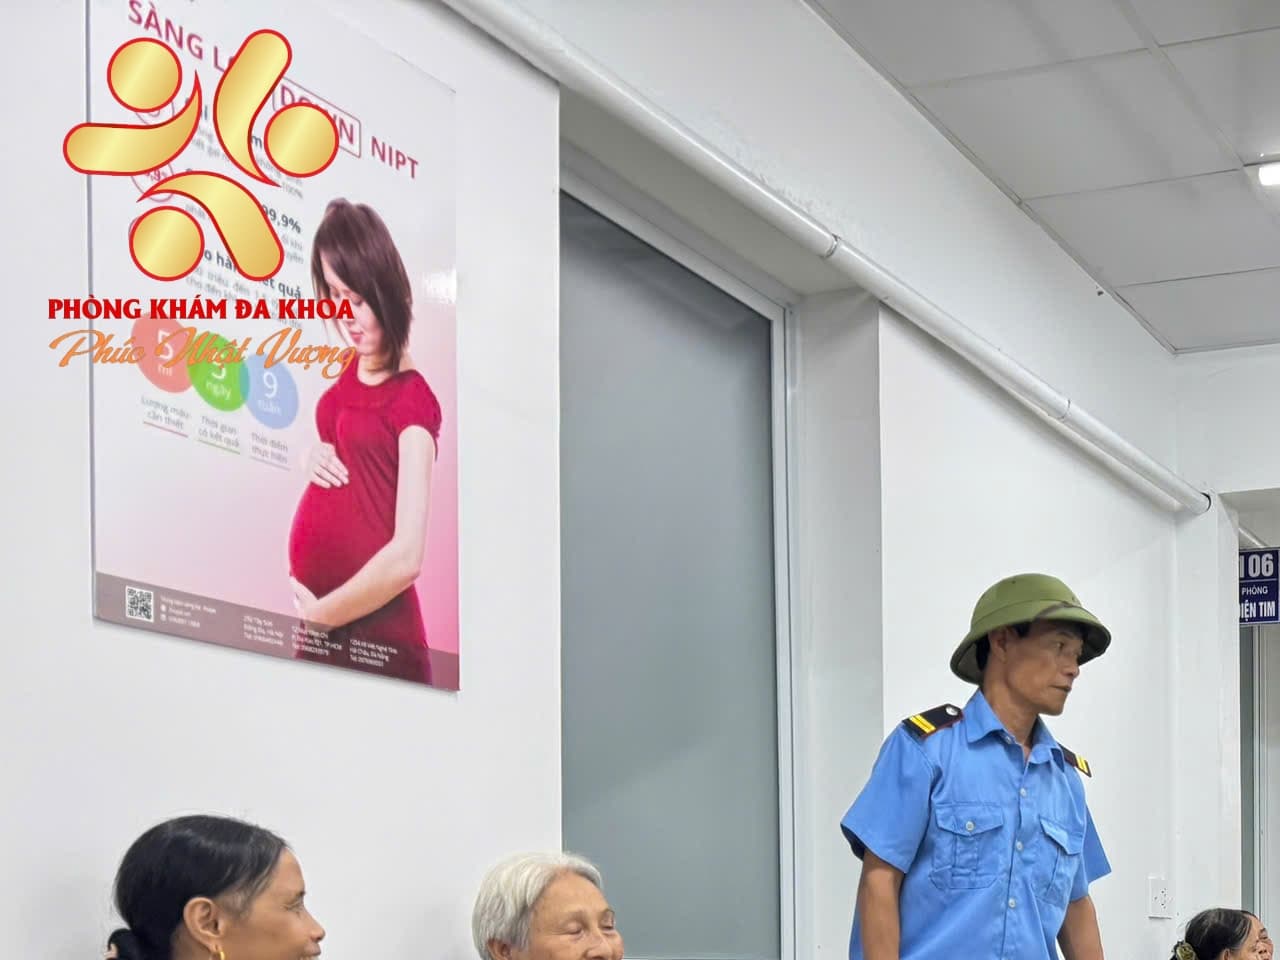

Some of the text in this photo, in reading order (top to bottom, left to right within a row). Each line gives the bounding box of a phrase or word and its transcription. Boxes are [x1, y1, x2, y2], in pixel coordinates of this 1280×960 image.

[128, 0, 203, 60] SÀNG
[371, 135, 419, 180] NIPT
[263, 371, 278, 399] 9
[1241, 585, 1268, 595] PHÒNG
[1239, 599, 1276, 622] IỆN TIM
